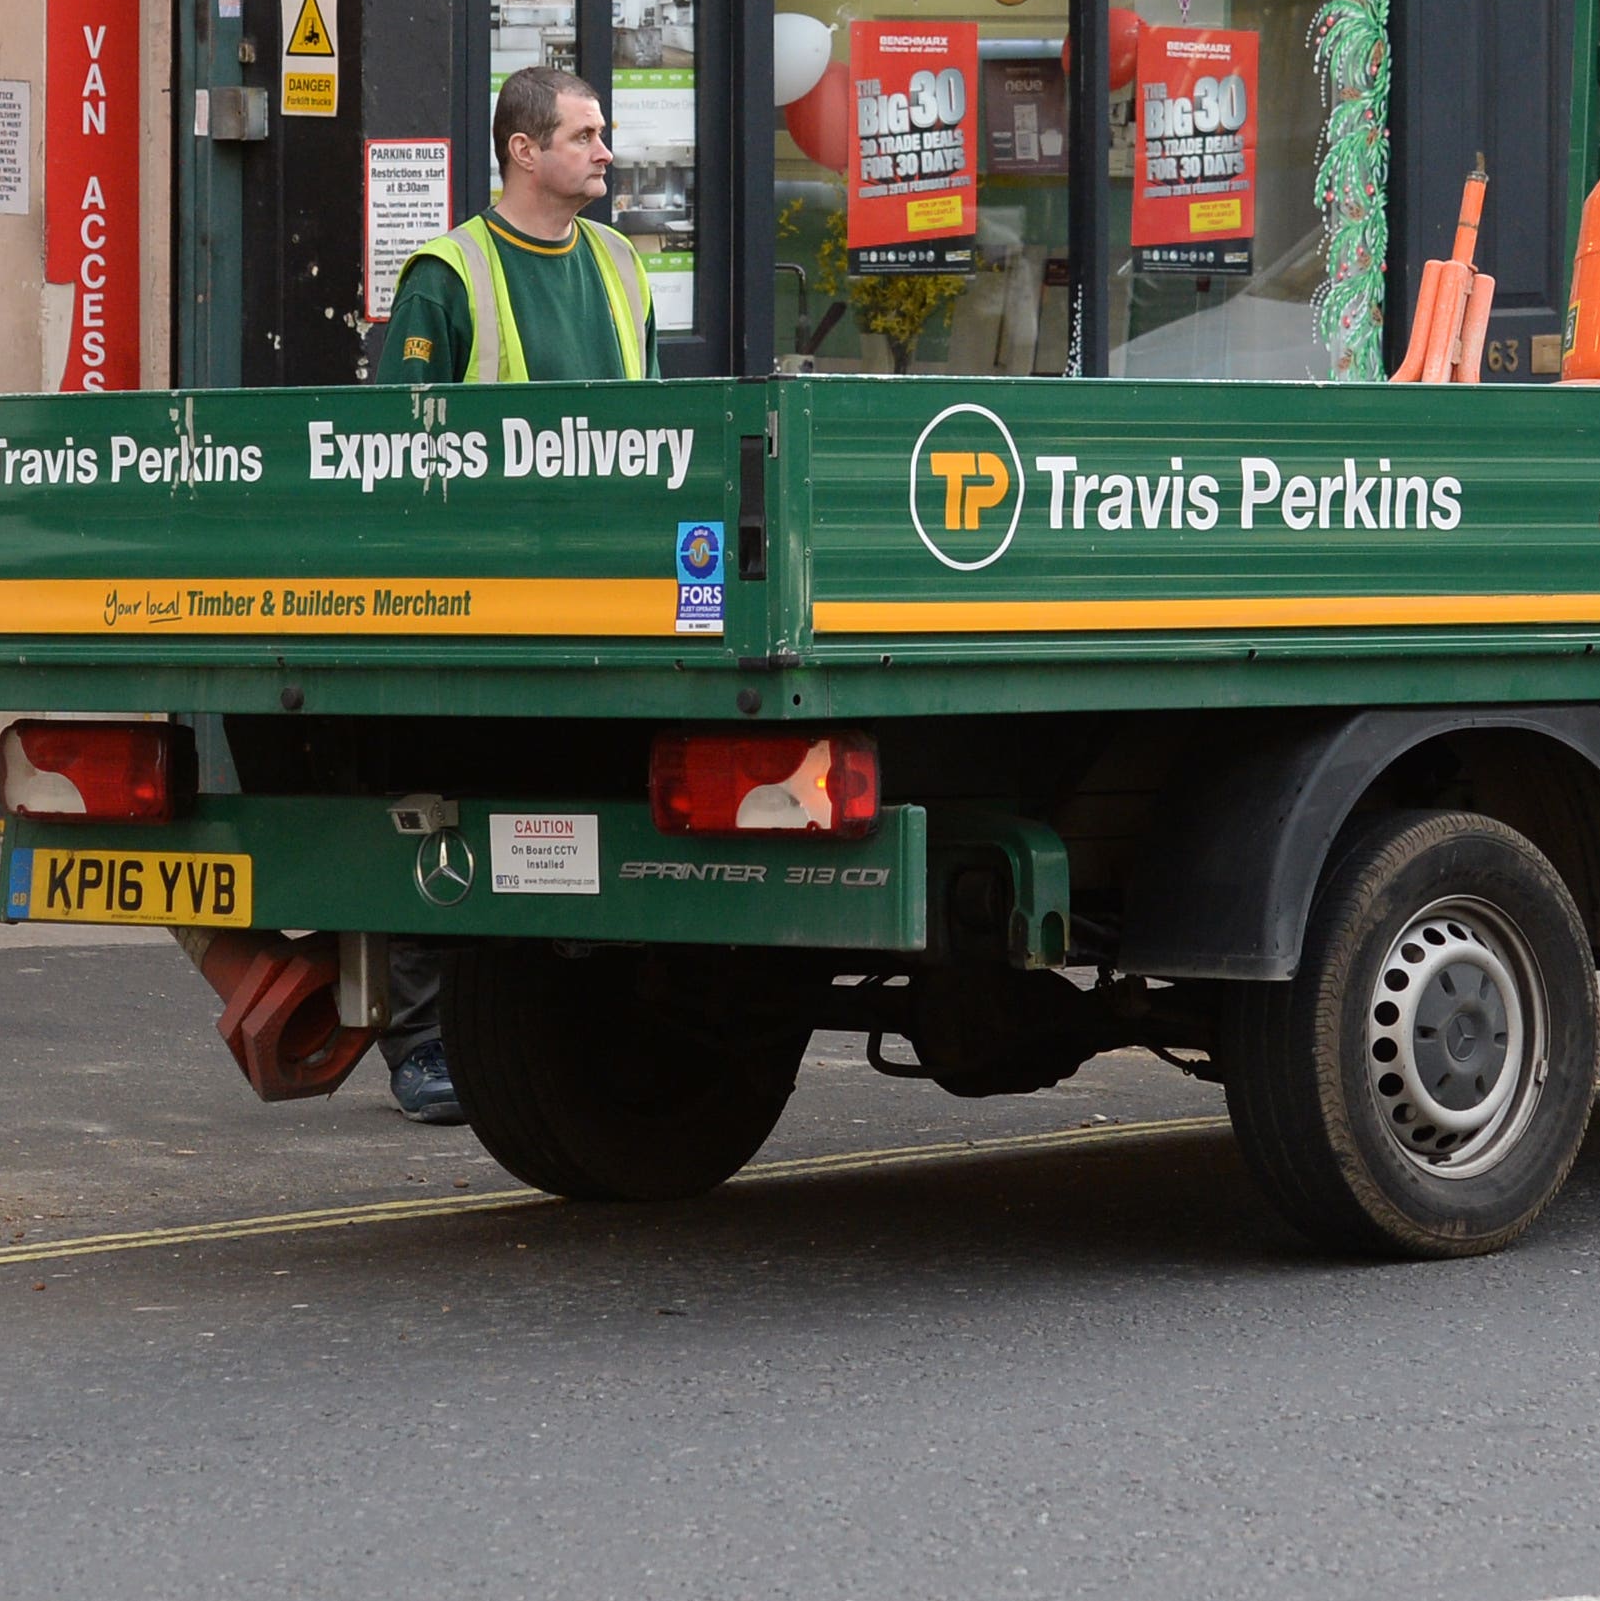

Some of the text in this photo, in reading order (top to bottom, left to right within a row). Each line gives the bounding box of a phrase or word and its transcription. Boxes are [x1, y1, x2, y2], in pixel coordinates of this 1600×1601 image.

[879, 35, 948, 46] BENCHMARX
[1166, 41, 1231, 53] BENCHMARX
[83, 25, 106, 135] VAN
[289, 79, 331, 91] DANGER
[856, 79, 881, 97] THE
[1006, 79, 1043, 92] neue
[1143, 82, 1167, 99] THE
[287, 96, 331, 106] Forklift trucks
[909, 67, 966, 128] 30
[1194, 75, 1247, 133] 30
[858, 93, 910, 138] BIG
[1144, 97, 1192, 139] BIG
[371, 148, 445, 160] PARKING RULES
[860, 130, 964, 157] 30 TRADE DEALS
[1146, 135, 1244, 157] 30 TRADE DEALS
[371, 167, 445, 179] Restrictions start
[861, 149, 966, 180] FOR 30 DAYS
[1148, 153, 1244, 180] FOR 30 DAYS
[387, 182, 430, 193] at 8:30am
[1488, 340, 1519, 372] 63
[110, 430, 263, 484] Perkins
[309, 415, 694, 494] Express Delivery
[930, 452, 1462, 532] TP Travis Perkins
[681, 586, 722, 605] FORS
[104, 589, 471, 626] Your local Timber & Builders Merchant
[514, 820, 573, 833] CAUTION
[511, 845, 578, 855] On Board CCTV
[527, 860, 564, 869] Installed
[619, 862, 891, 887] SPRINTER 313 CDI
[46, 858, 235, 915] KP16 YVB
[12, 893, 27, 906] GB
